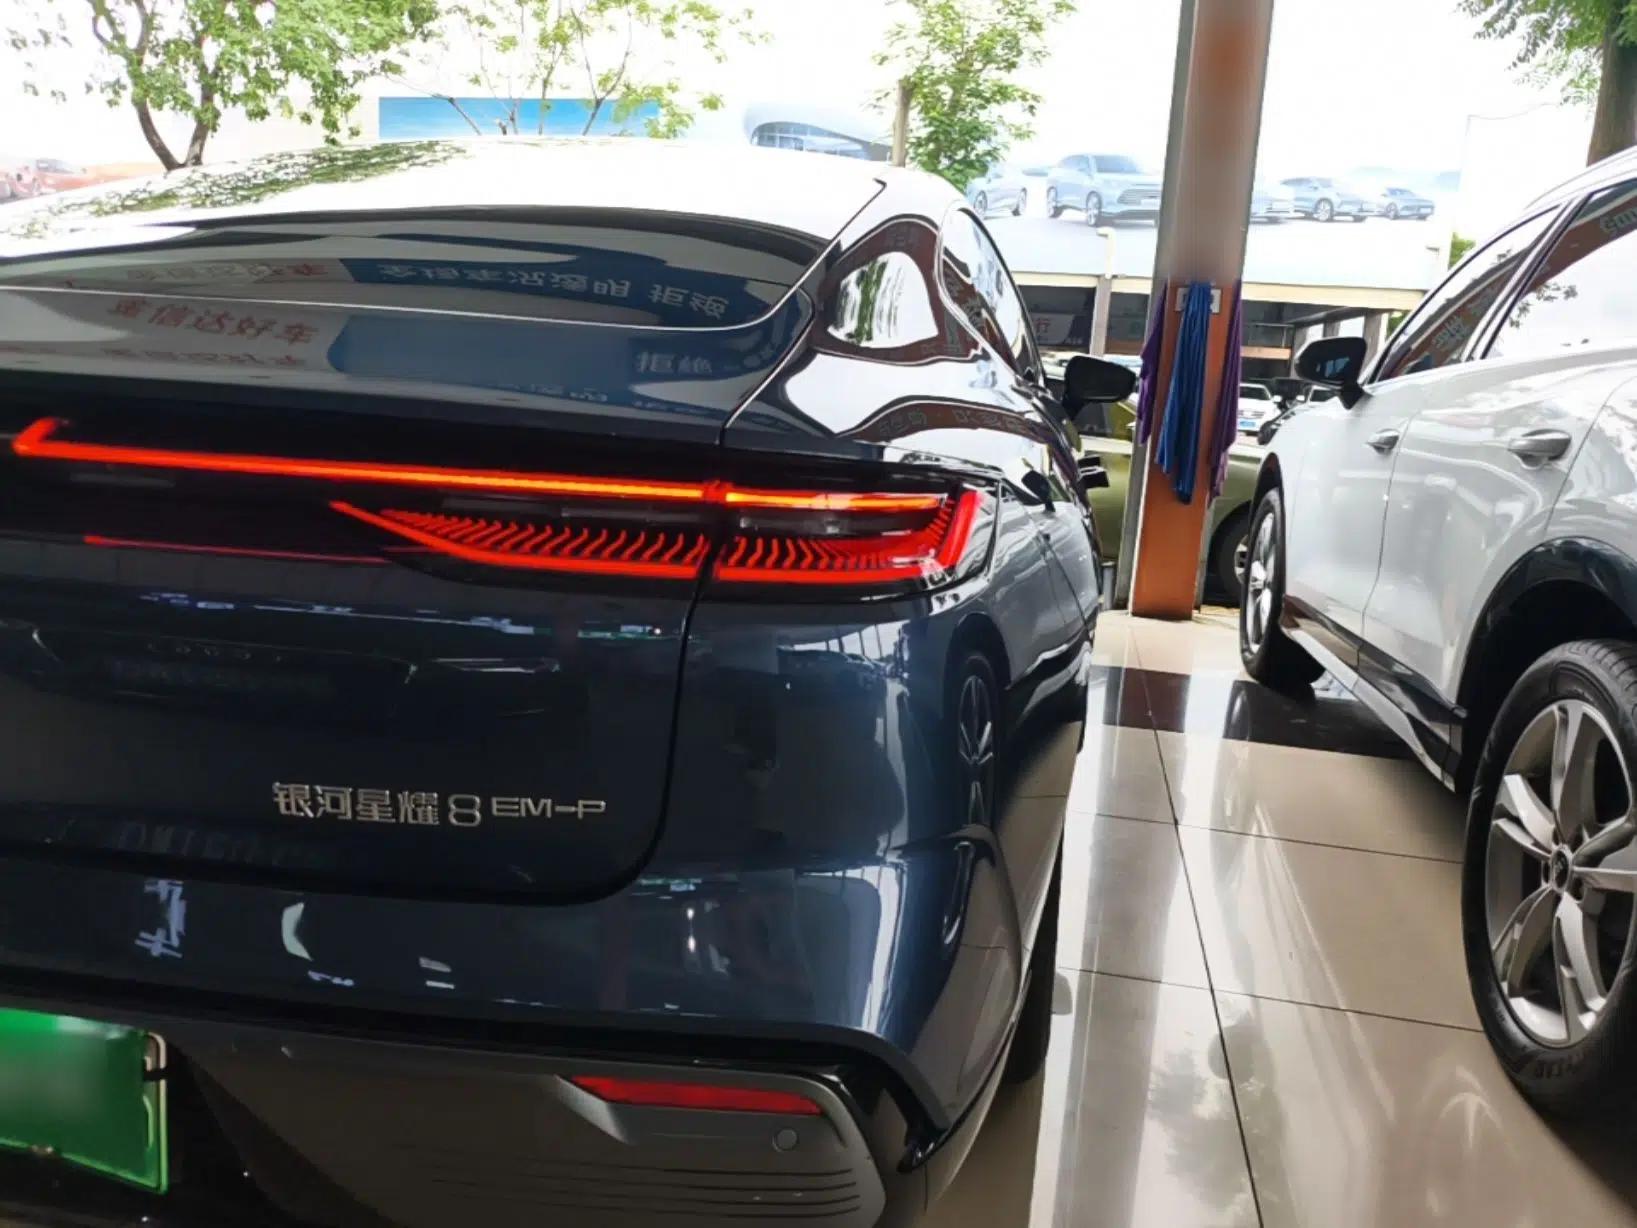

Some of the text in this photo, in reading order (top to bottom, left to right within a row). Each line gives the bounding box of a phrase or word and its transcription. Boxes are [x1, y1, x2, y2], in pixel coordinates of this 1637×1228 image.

[273, 781, 607, 827] 银河星耀 8 EM-P
